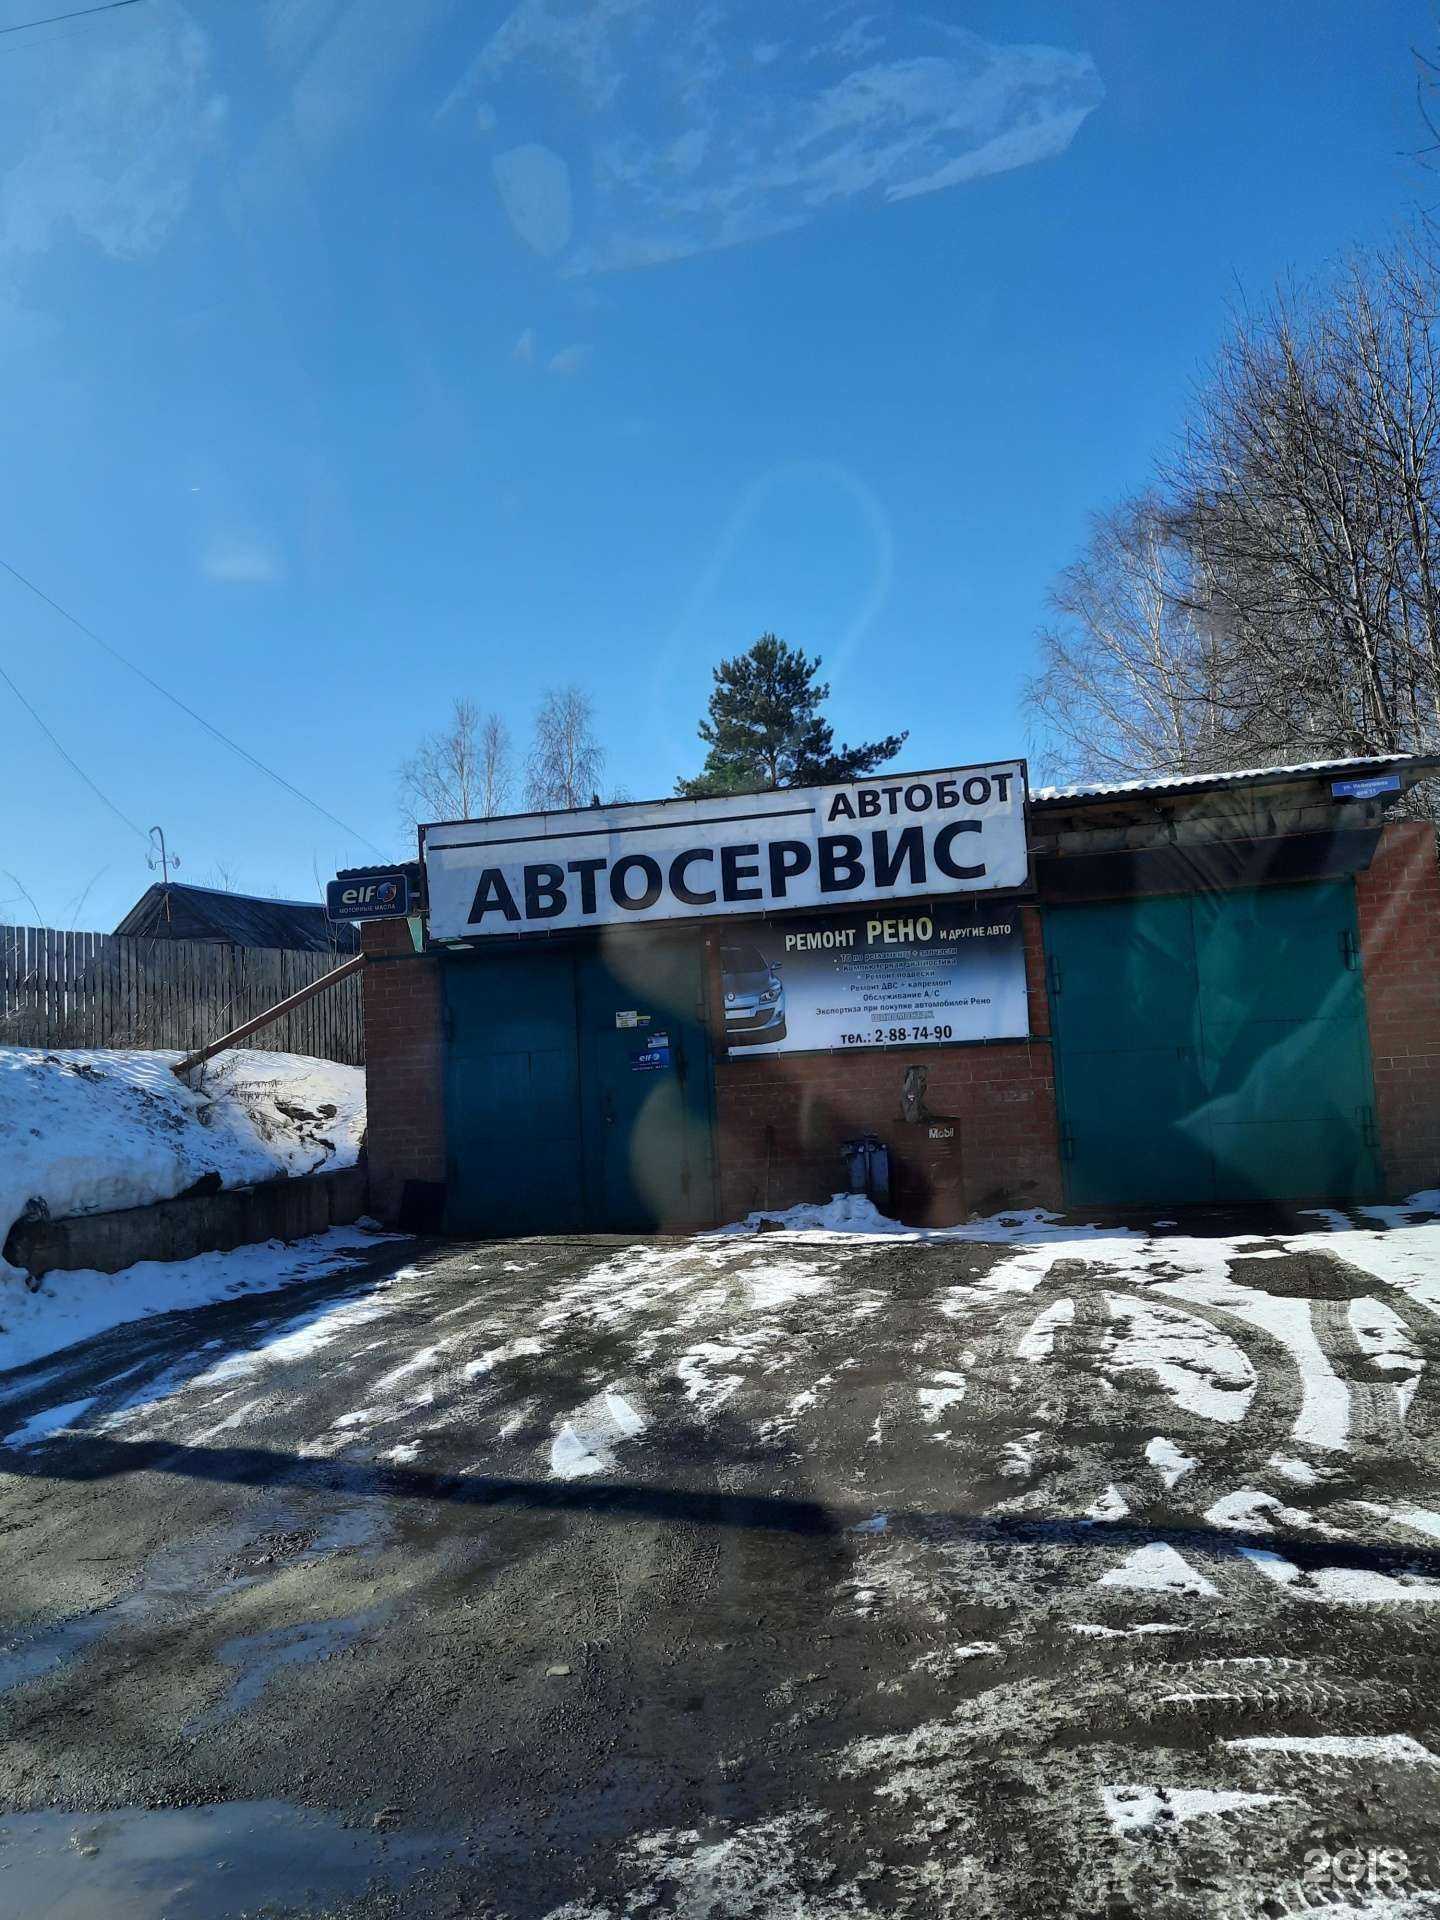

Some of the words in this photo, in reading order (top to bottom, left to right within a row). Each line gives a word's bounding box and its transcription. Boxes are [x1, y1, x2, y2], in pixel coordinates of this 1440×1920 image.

[828, 773, 1013, 822] АВТОБОТ
[467, 820, 988, 925] АВТОСЕРВИС
[342, 885, 376, 904] elf
[785, 929, 856, 951] РЕМОНТ
[866, 917, 933, 945] РЕНО
[939, 930, 947, 939] И
[948, 926, 985, 940] ДРУГИЕ
[986, 924, 1012, 936] АВТО
[881, 981, 898, 991] ДВС
[970, 997, 991, 1006] Рено
[874, 1024, 953, 1043] 2-88-74-90
